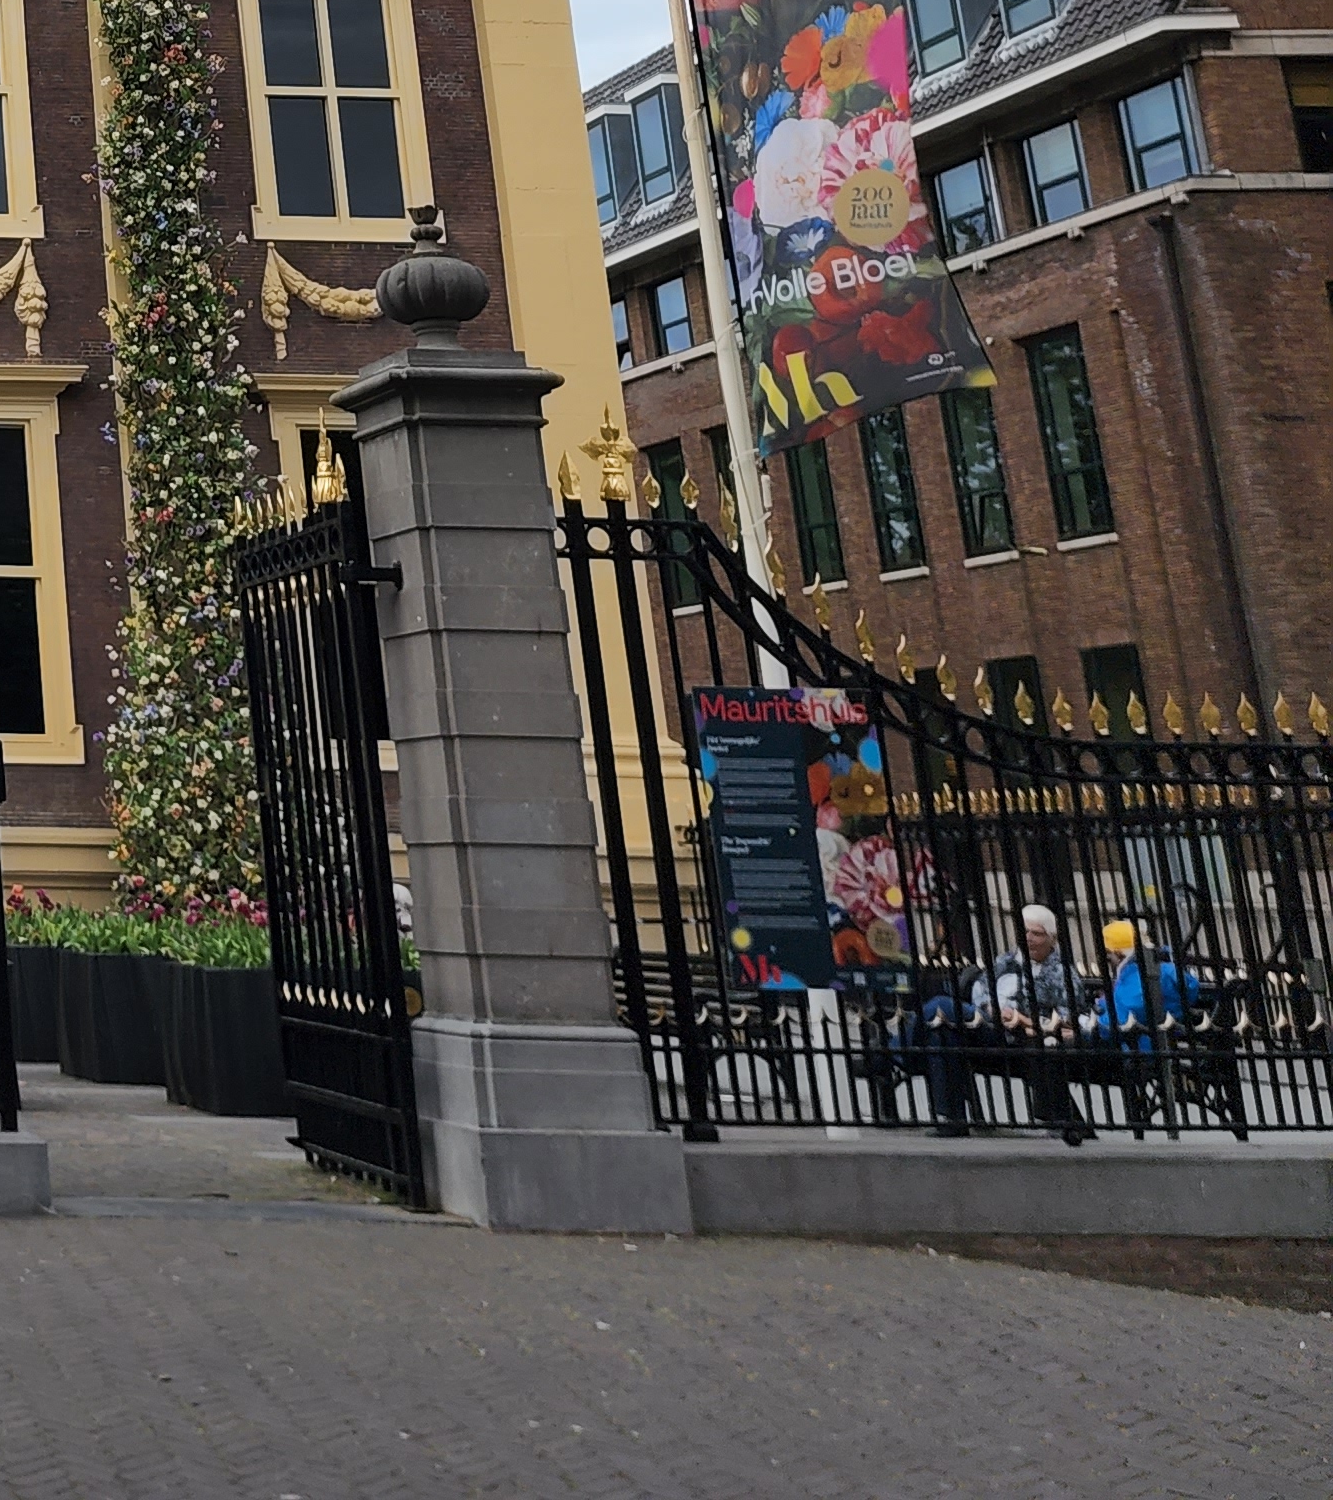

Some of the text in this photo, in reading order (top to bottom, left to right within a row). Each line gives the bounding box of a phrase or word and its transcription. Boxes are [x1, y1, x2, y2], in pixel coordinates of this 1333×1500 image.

[851, 186, 893, 202] 200
[850, 203, 894, 220] jaar
[762, 267, 827, 306] Volle
[831, 245, 918, 290] Bloei
[699, 693, 869, 725] Mauritshuis
